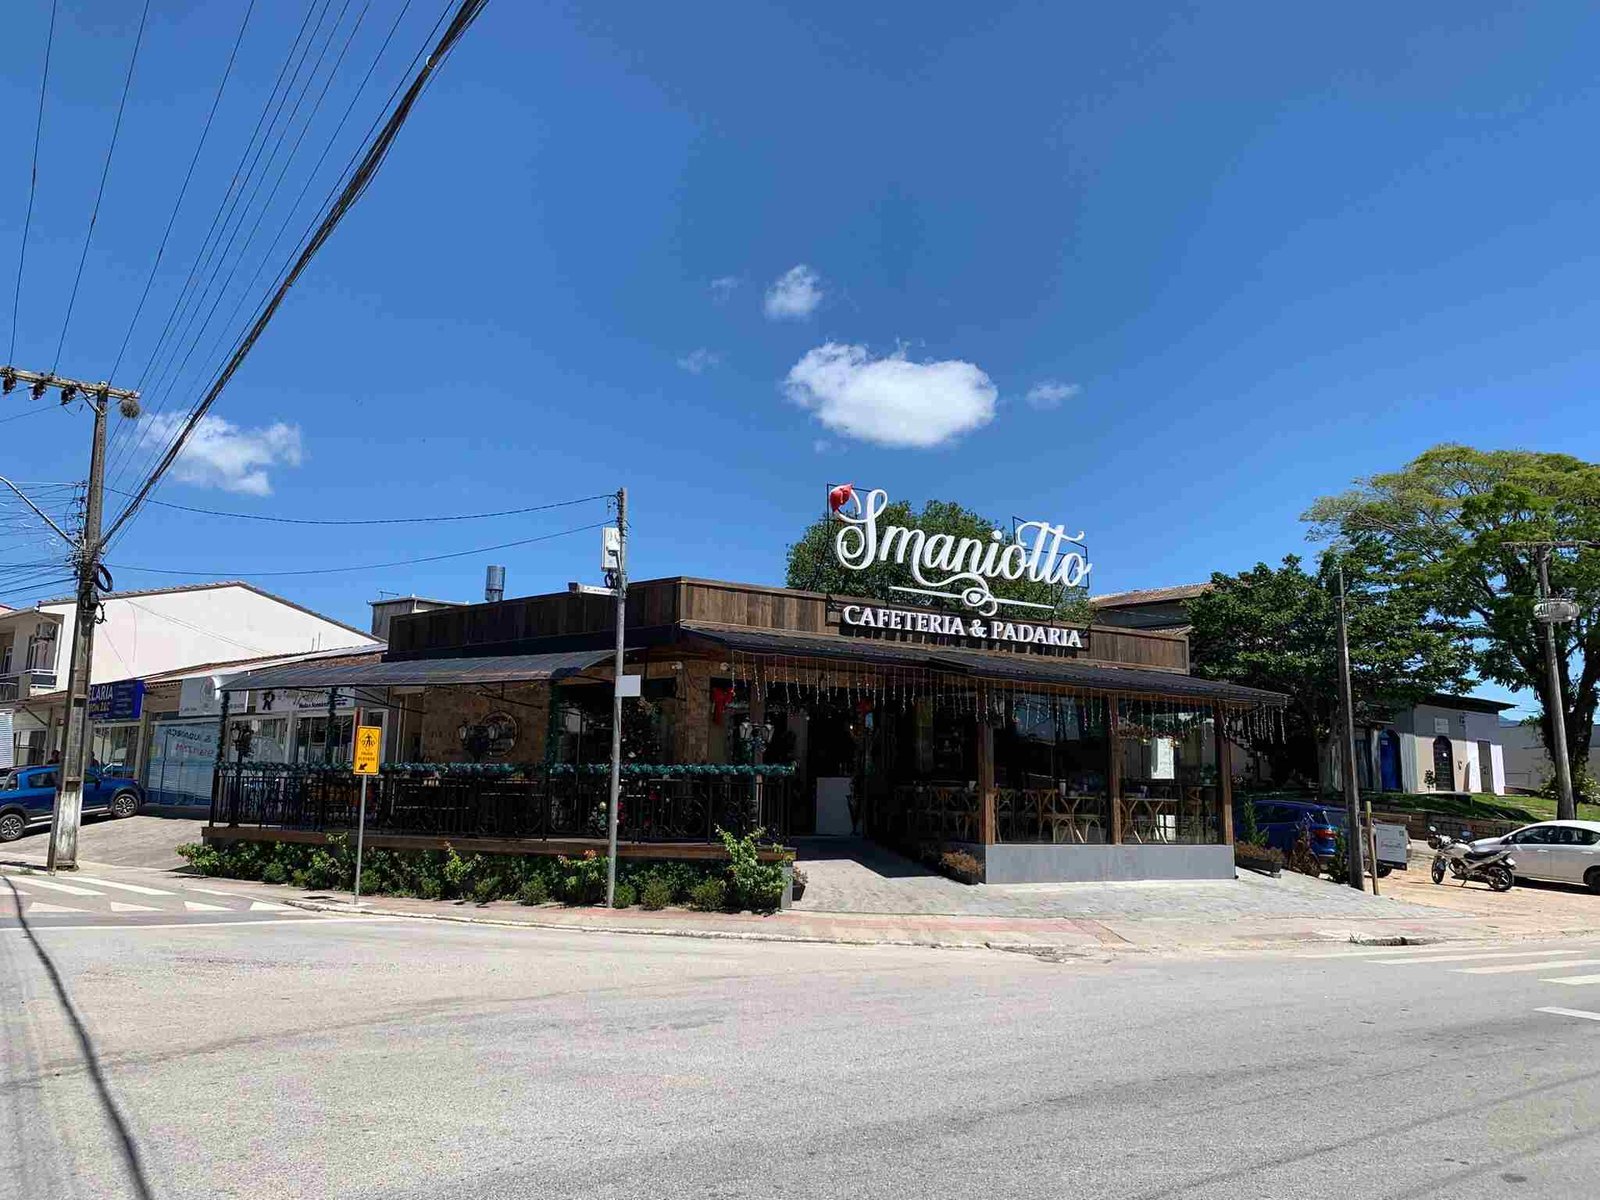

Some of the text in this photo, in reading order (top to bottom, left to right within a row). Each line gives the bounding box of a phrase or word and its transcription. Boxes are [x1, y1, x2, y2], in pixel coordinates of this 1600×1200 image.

[834, 488, 1093, 616] Smaniotto
[843, 605, 1083, 648] CAFETERIA & PADARIA
